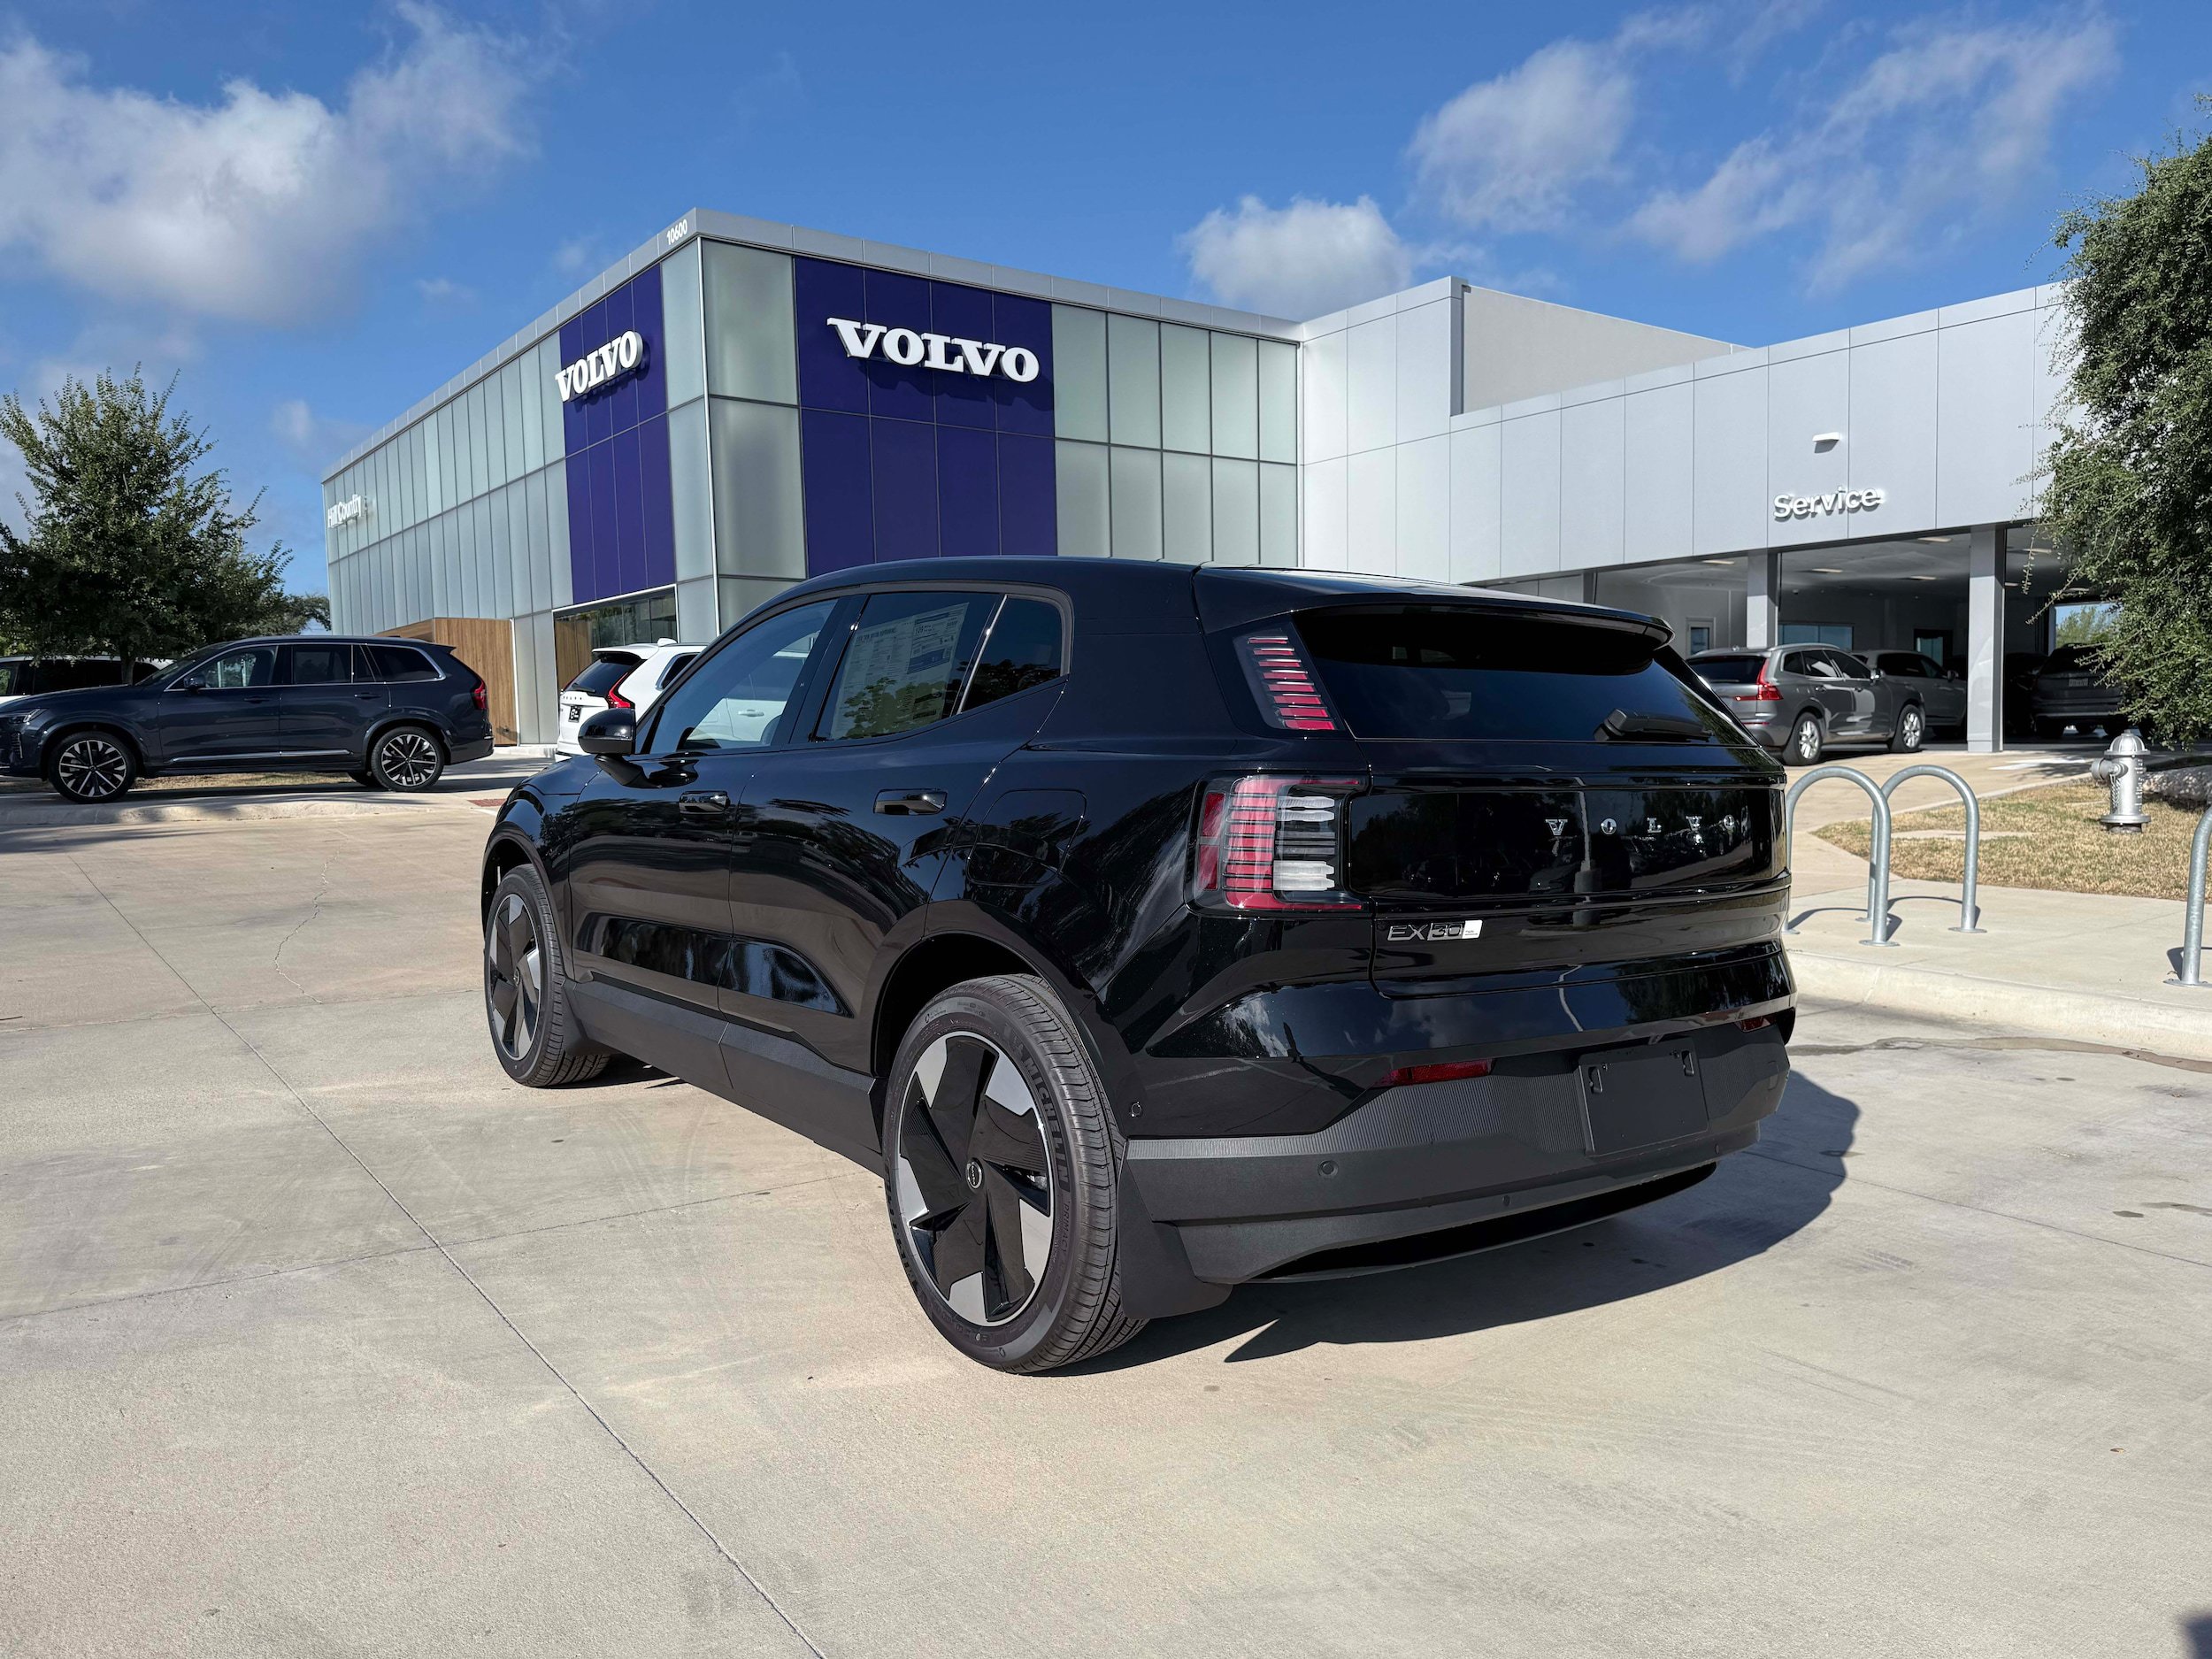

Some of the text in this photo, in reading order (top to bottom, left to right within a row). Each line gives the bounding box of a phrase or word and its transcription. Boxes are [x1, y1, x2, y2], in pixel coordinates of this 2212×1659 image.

[666, 219, 687, 246] 10600
[555, 330, 642, 403] VOLVO
[827, 317, 1040, 383] VOLVO
[1773, 486, 1878, 518] Service
[1545, 814, 1734, 836] VOLVO
[1023, 1056, 1071, 1187] MICHELIN
